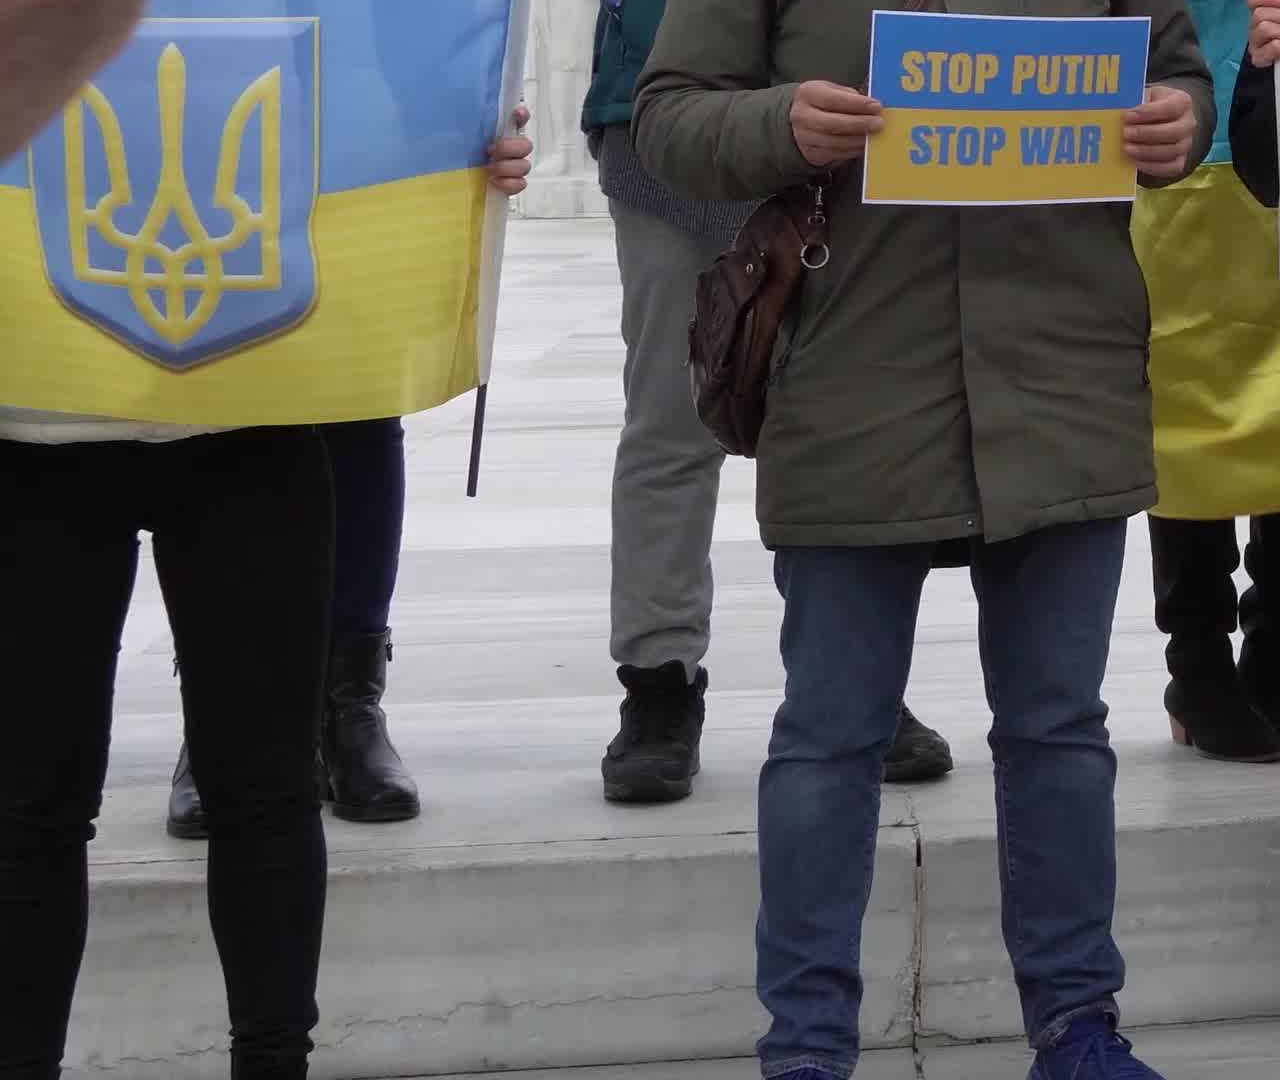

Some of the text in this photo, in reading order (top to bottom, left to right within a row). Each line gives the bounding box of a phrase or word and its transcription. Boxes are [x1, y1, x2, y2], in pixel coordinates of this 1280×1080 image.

[901, 51, 1120, 96] STOP PUTIN
[909, 125, 1102, 166] STOP WAR
